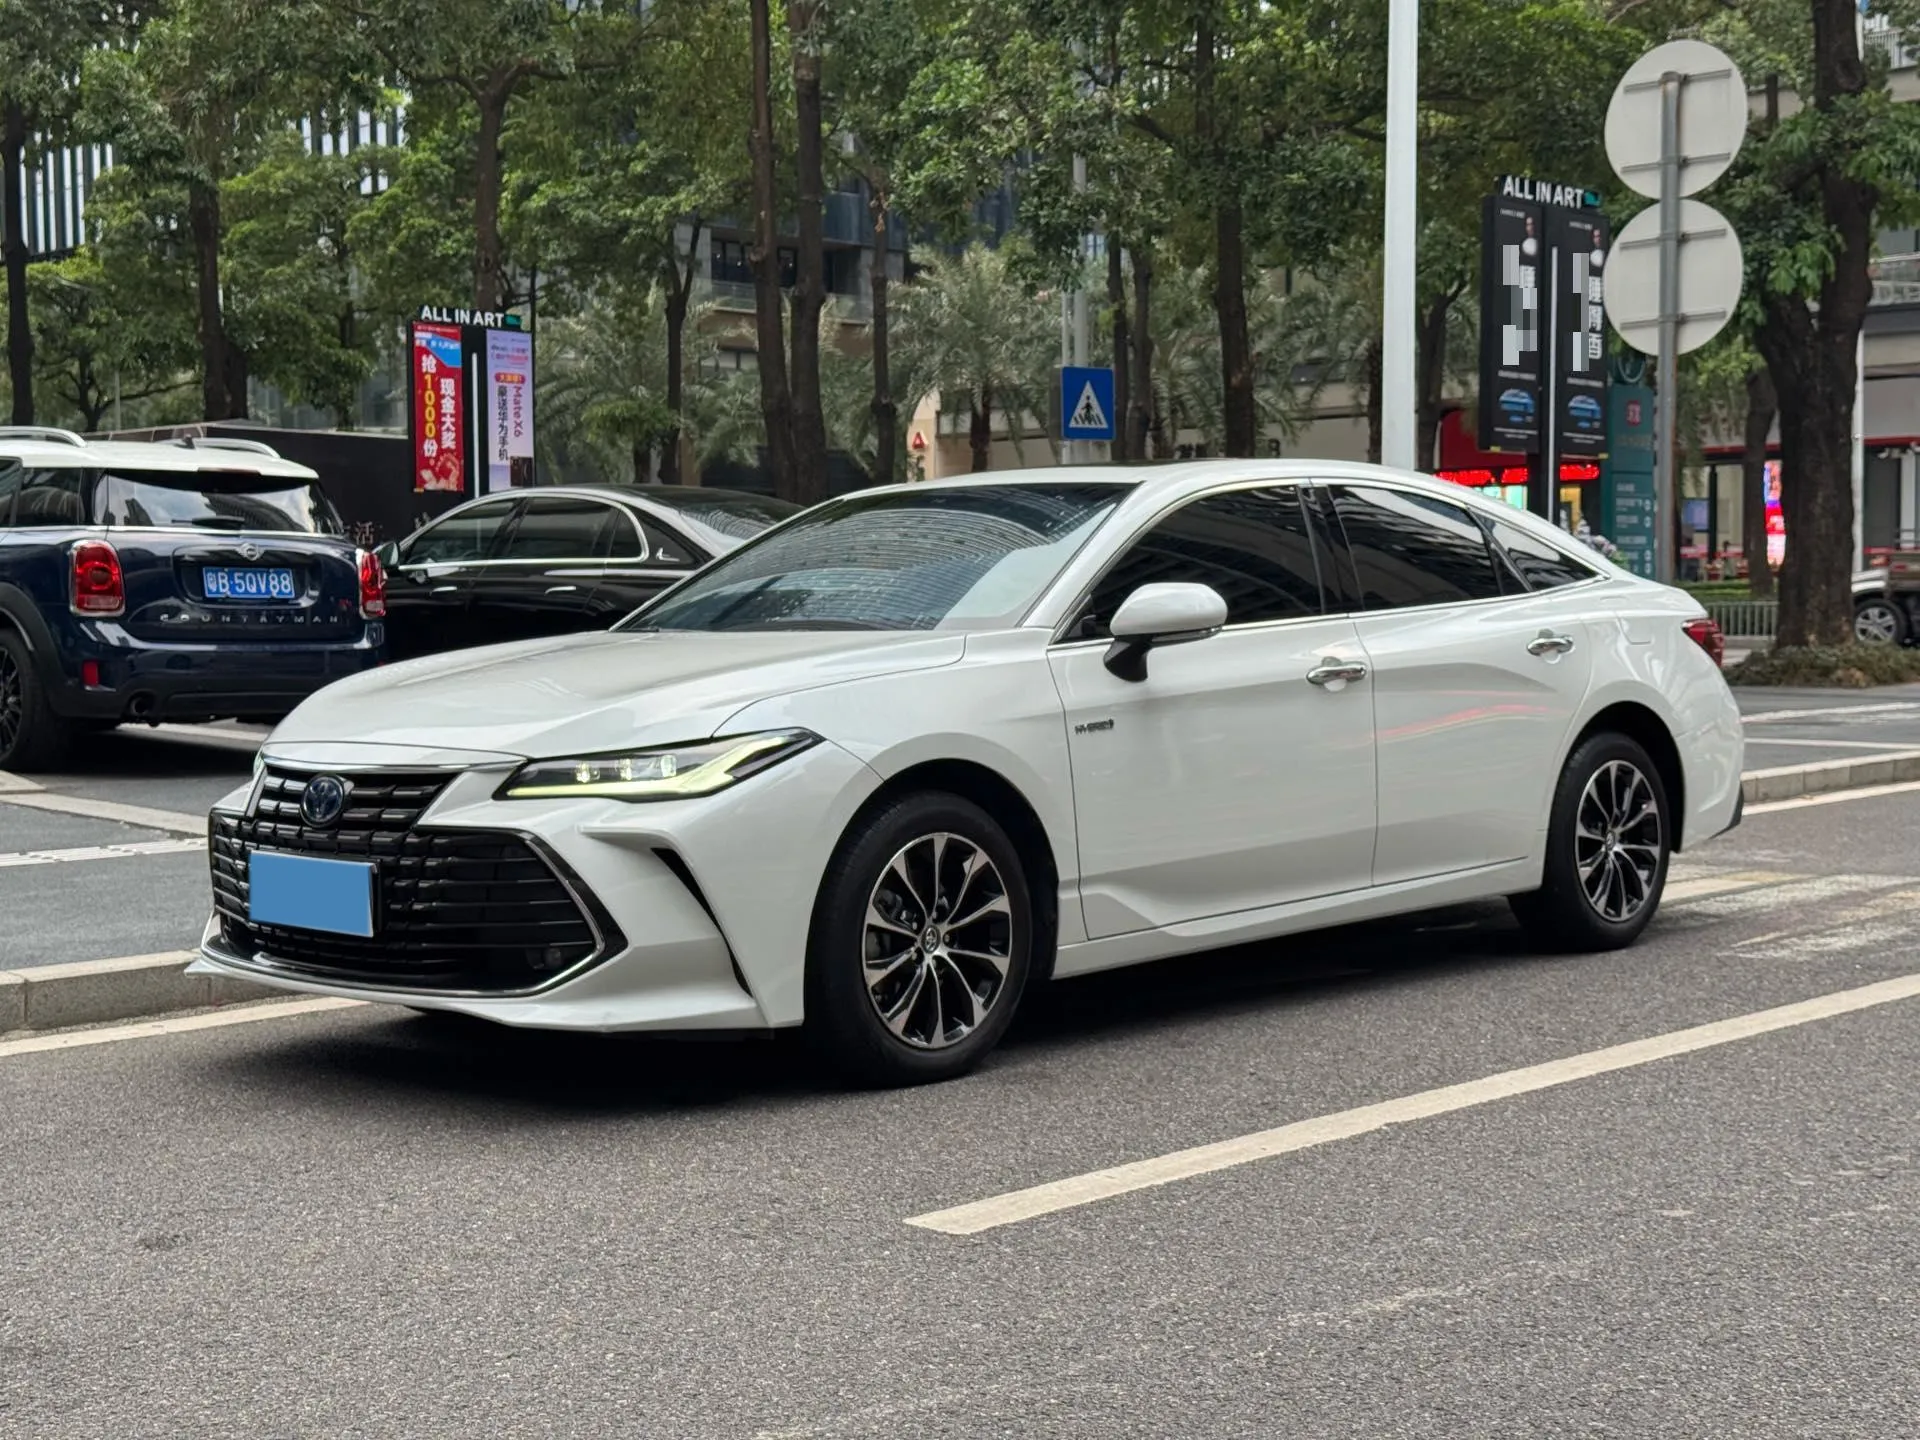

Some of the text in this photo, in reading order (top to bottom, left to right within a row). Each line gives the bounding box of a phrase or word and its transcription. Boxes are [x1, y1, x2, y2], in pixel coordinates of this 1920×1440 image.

[1502, 174, 1585, 210] ALL IN ART
[421, 304, 453, 323] ALL
[454, 308, 471, 325] IN
[472, 311, 505, 329] ART
[440, 377, 457, 449] 现金大奖
